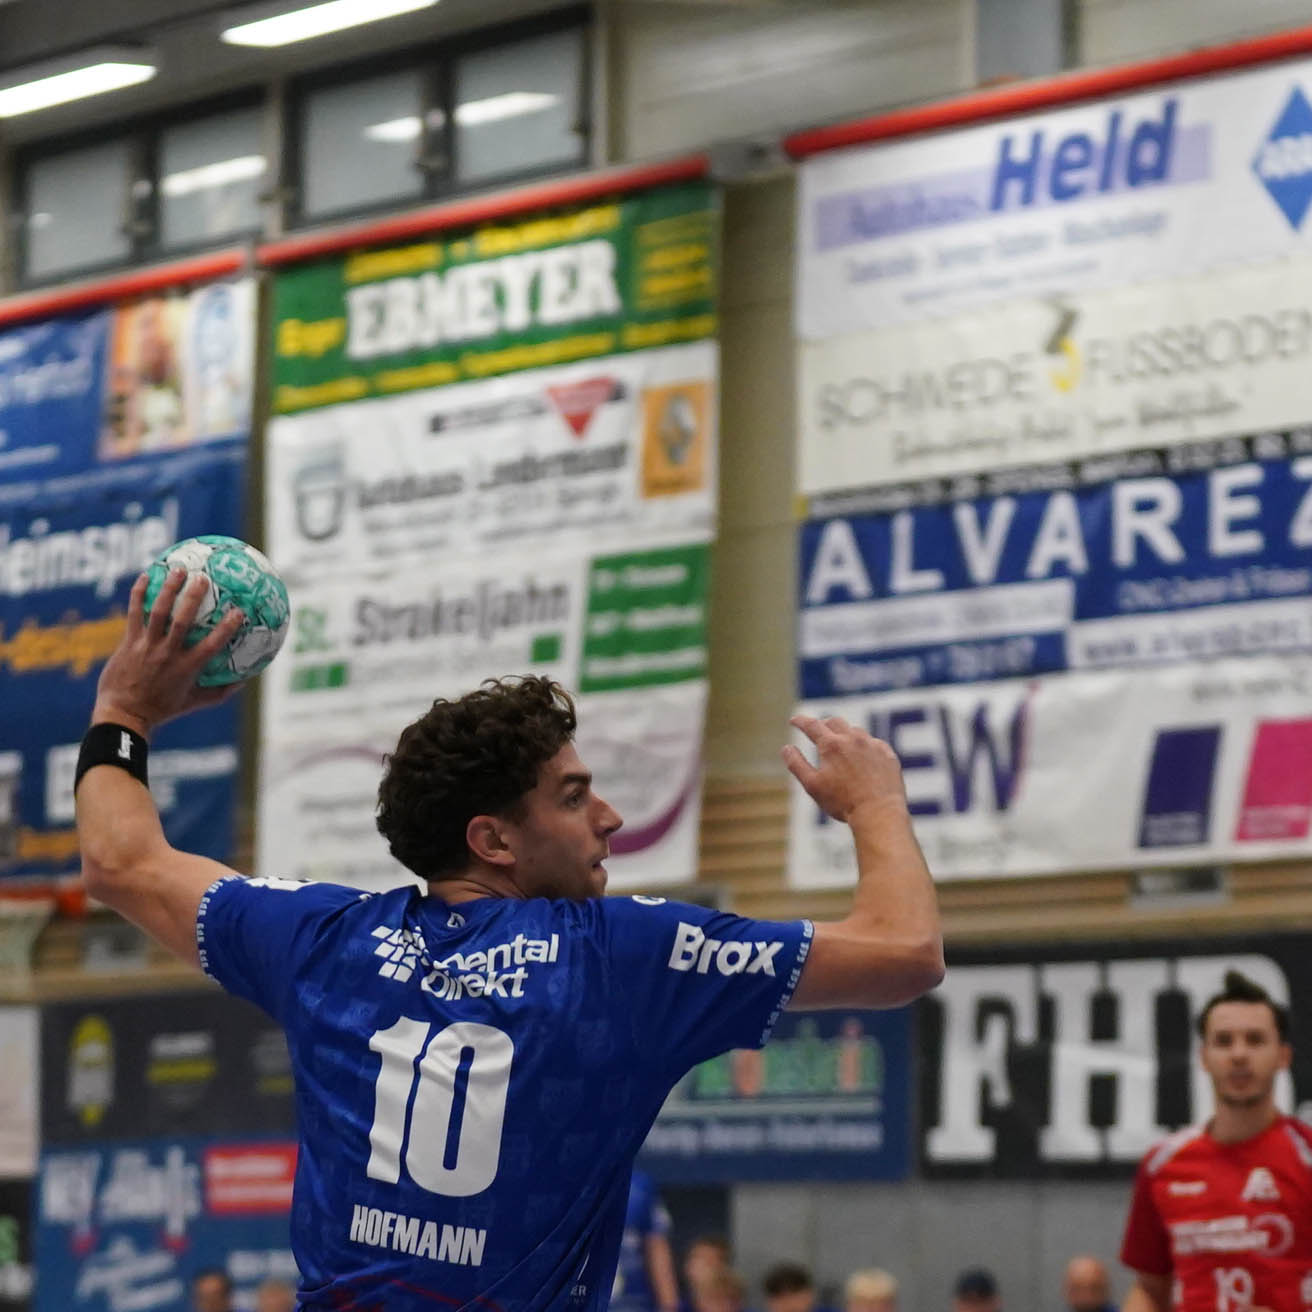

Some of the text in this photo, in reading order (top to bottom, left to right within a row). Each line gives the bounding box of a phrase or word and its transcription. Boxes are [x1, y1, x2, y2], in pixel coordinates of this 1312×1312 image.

[992, 97, 1180, 210] Held
[668, 921, 784, 976] Brax
[367, 1016, 514, 1197] 10
[350, 1203, 487, 1267] HOFMANN
